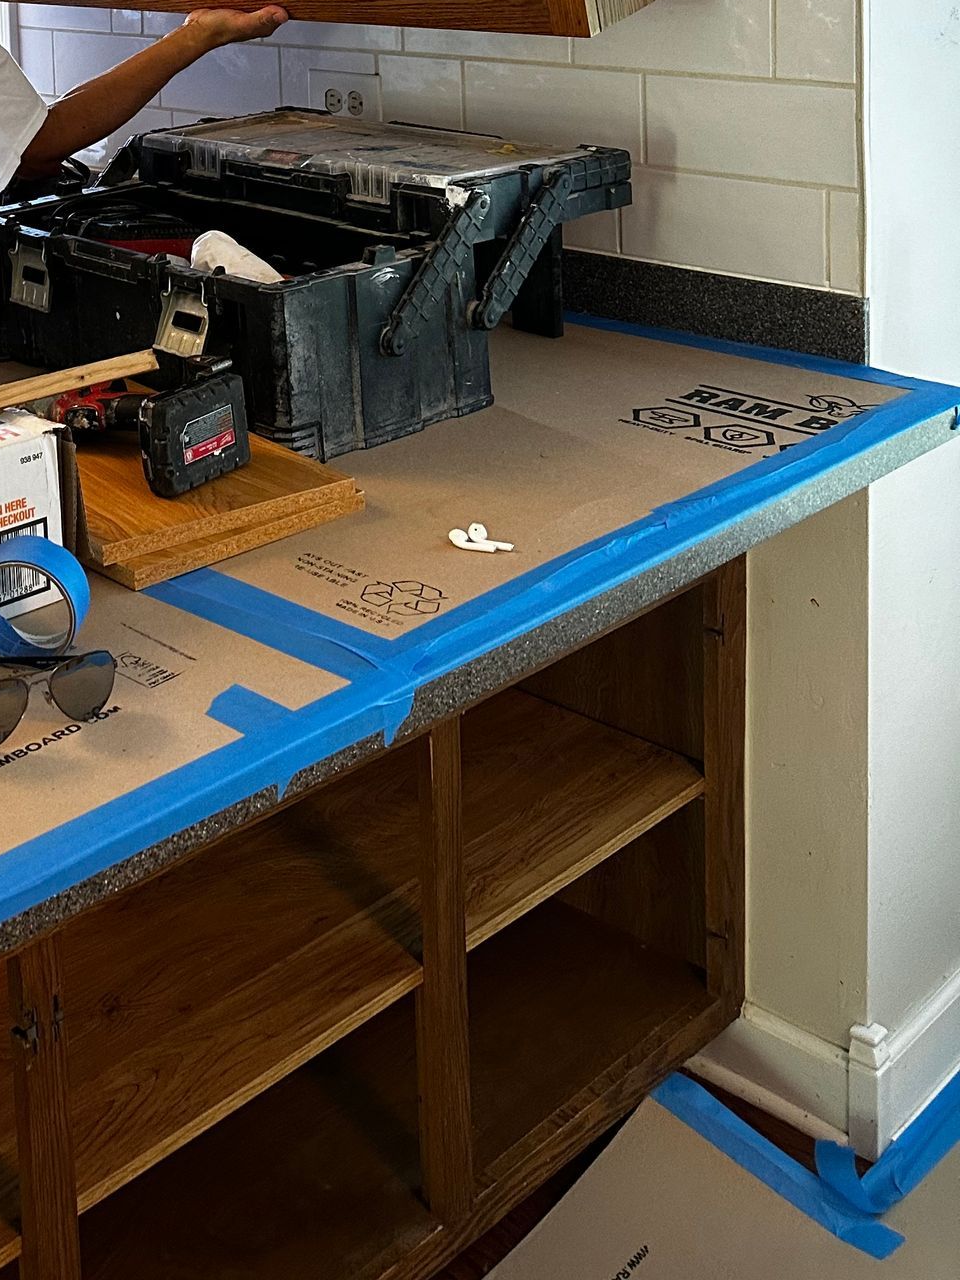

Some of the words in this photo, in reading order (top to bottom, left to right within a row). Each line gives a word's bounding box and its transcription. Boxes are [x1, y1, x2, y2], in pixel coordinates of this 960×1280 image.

[680, 389, 793, 420] RAM
[19, 455, 32, 465] 938
[31, 452, 43, 463] 947
[4, 497, 27, 514] HERE
[324, 559, 343, 569] OUT
